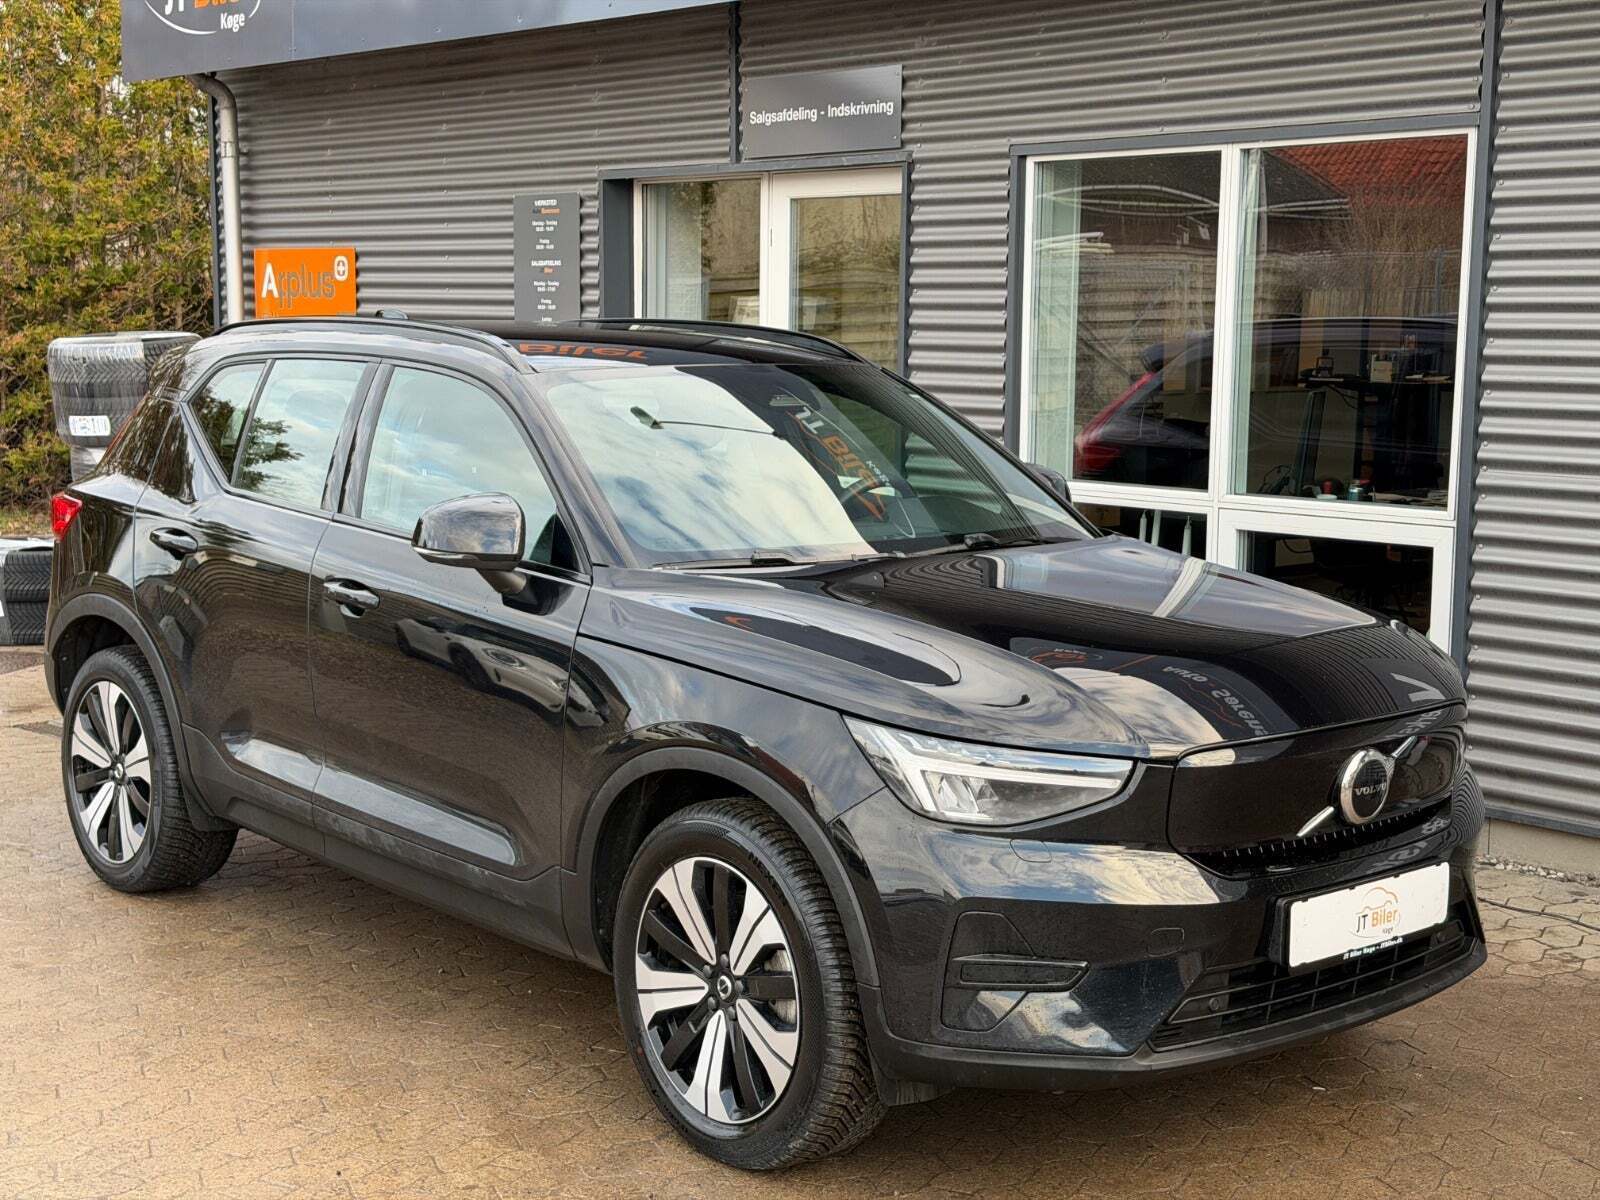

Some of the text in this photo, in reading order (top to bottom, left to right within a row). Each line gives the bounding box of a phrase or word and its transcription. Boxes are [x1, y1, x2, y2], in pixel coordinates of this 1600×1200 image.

[220, 12, 245, 32] Køge
[749, 107, 818, 126] Salgsafdeling
[827, 100, 894, 118] Indskrivning
[1355, 782, 1387, 796] VOLVO
[1356, 908, 1398, 933] JT Biler
